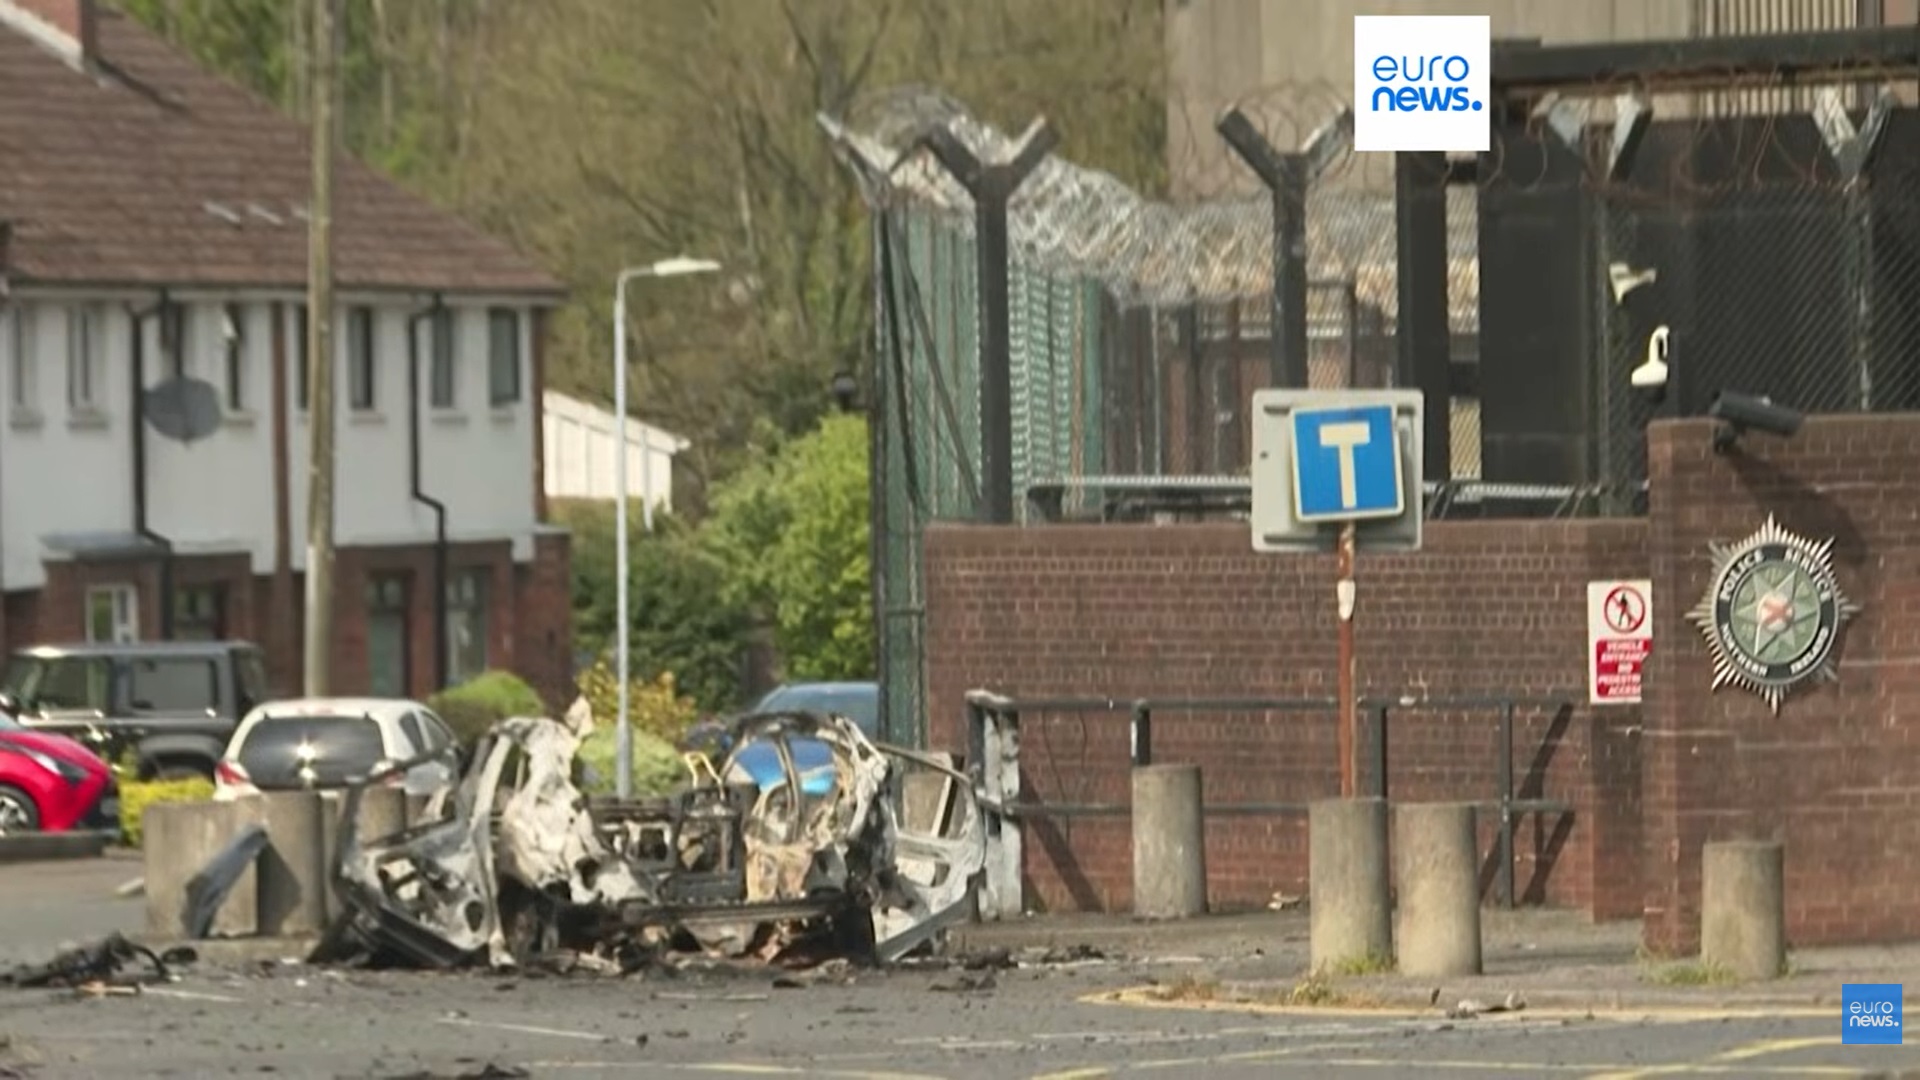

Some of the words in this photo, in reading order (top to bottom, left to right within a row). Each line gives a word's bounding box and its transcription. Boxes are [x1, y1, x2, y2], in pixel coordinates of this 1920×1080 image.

[1720, 549, 1764, 600] POLICE
[1784, 548, 1831, 601] SERVICE
[1601, 651, 1649, 662] ENTRANC
[1721, 623, 1768, 677] NORTHERN
